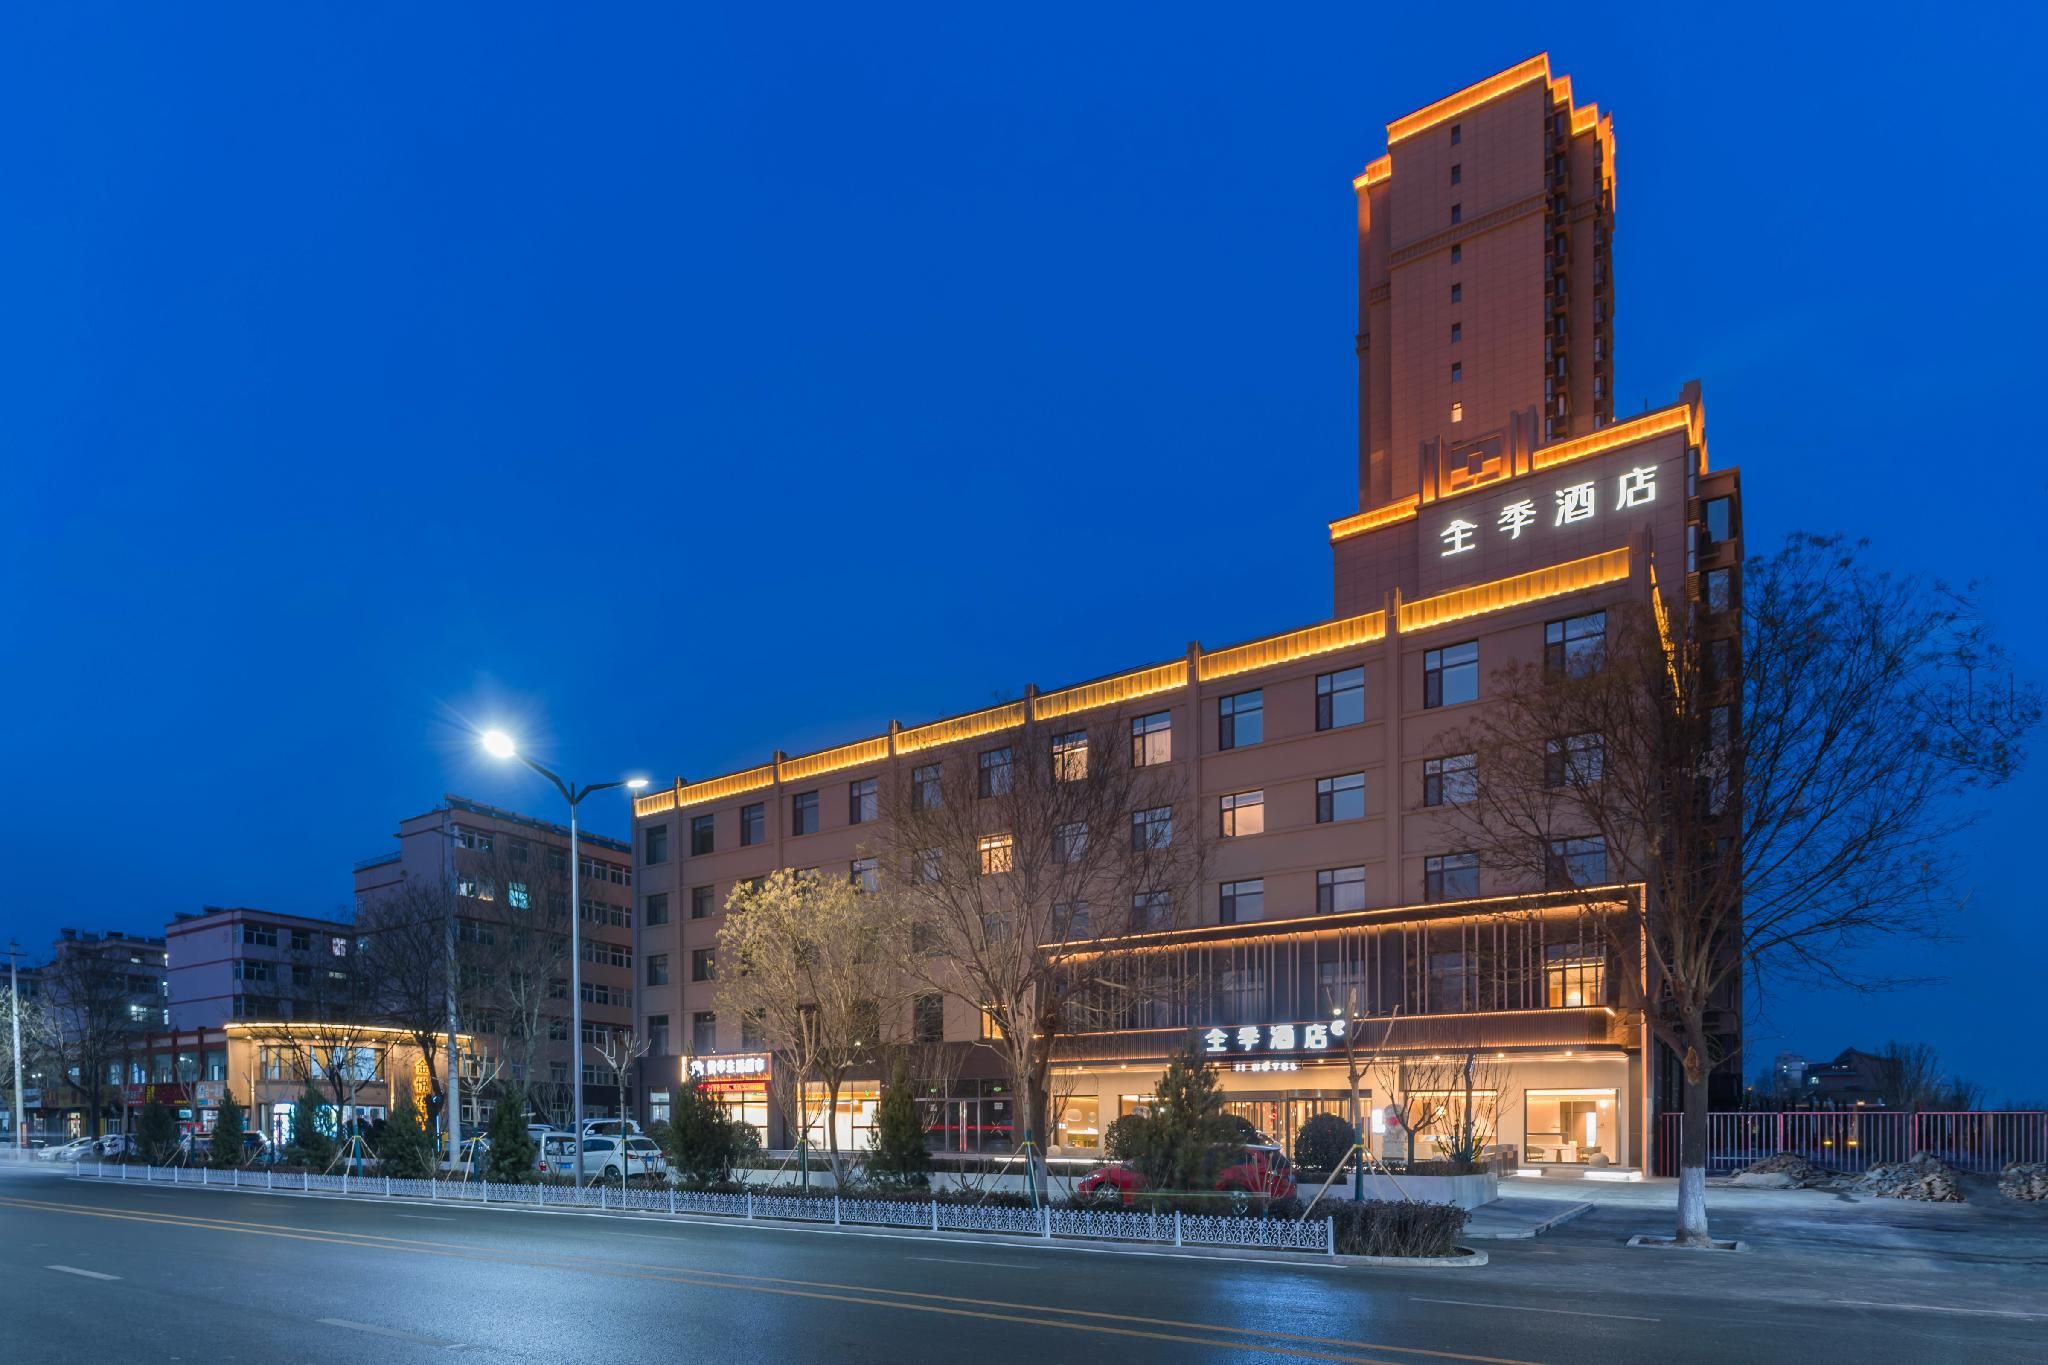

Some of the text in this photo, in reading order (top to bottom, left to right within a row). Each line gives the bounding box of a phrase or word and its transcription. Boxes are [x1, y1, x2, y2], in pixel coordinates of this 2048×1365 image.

[1440, 465, 1658, 557] 全季酒店
[1205, 1023, 1328, 1052] 全季酒店
[1251, 1061, 1298, 1072] HOTEL
